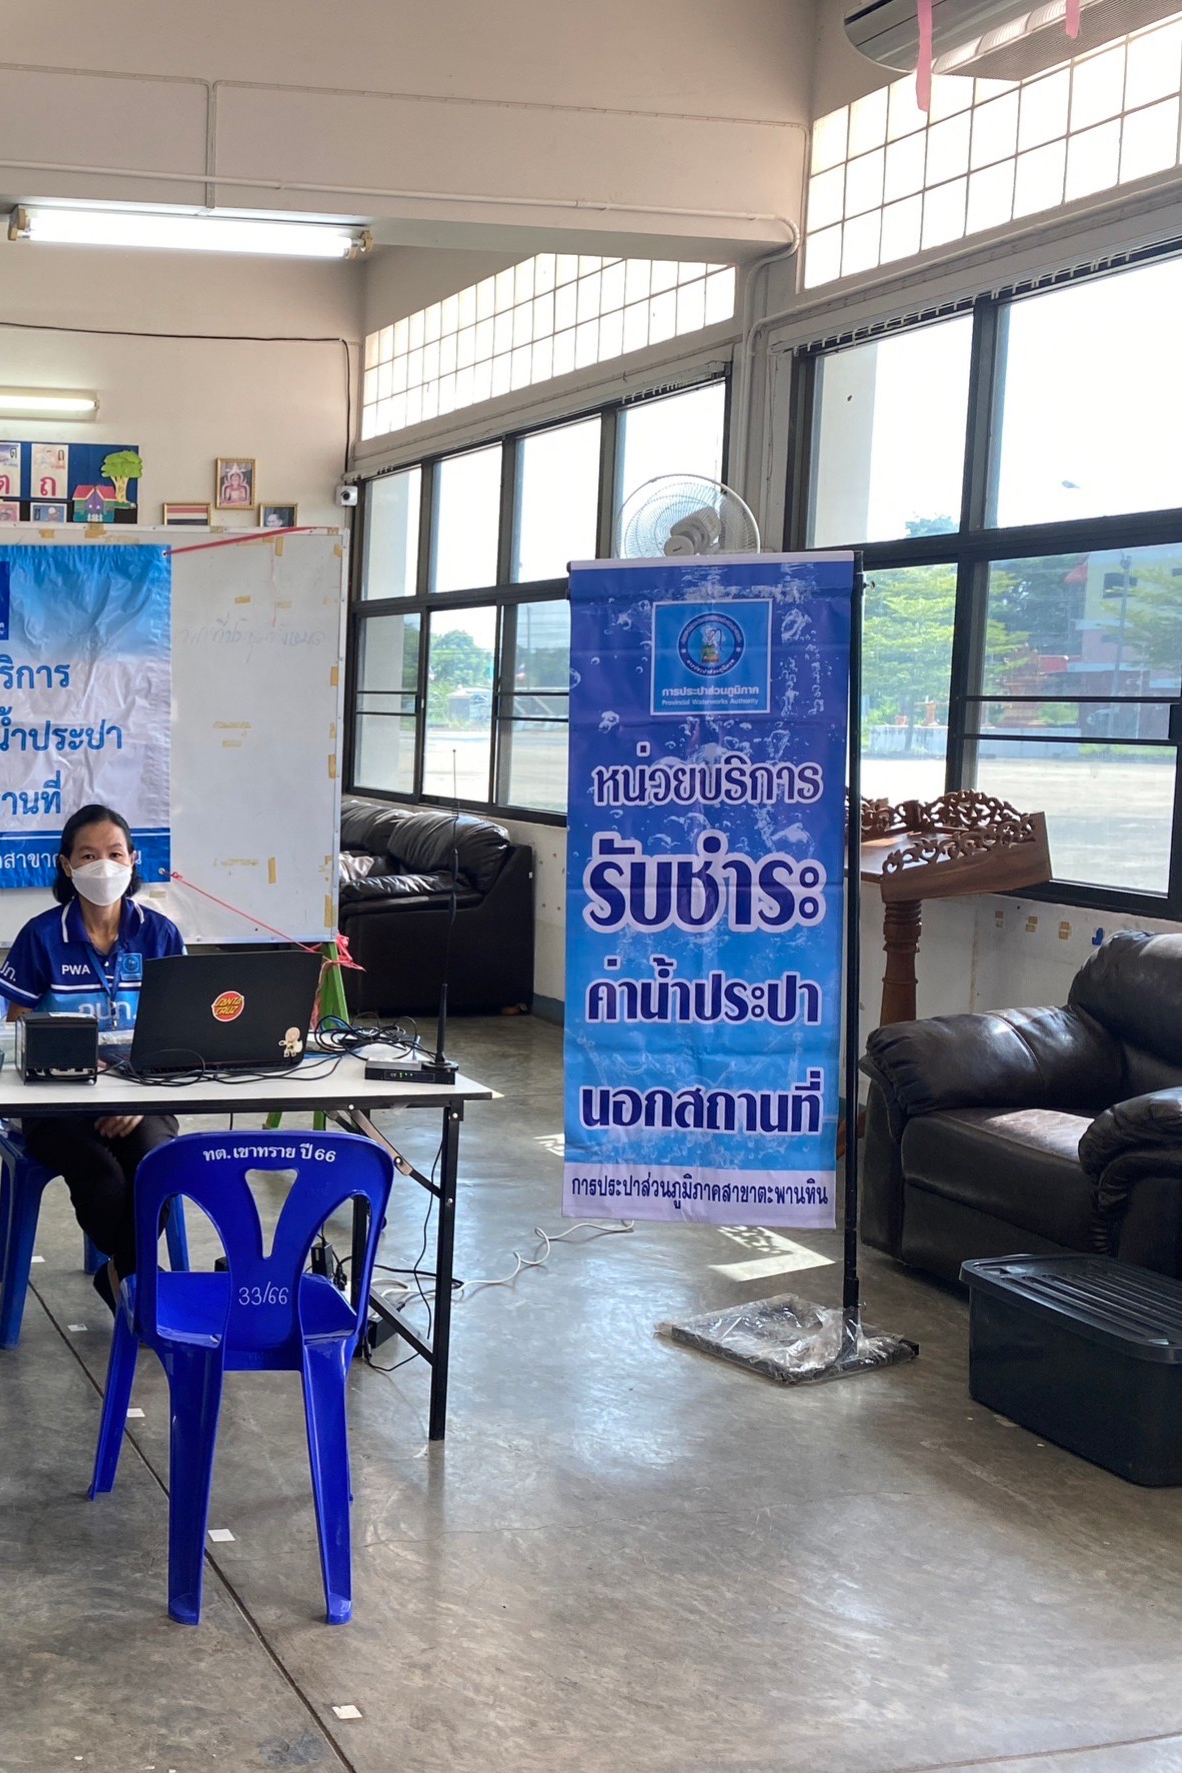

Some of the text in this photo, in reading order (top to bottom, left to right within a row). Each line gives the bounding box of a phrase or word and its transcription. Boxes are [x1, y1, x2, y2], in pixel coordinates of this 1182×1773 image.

[40, 477, 57, 496] ถ
[662, 685, 759, 698] การประปาส่วนภูมิภาค
[592, 742, 824, 805] หน่วยบริการ
[583, 829, 827, 932] รับชำระ
[61, 964, 91, 976] PWA
[585, 954, 821, 1026] ค่าน้ำประปา
[579, 1067, 825, 1136] นอกสถานที่
[571, 1171, 828, 1209] การประปาส่วนภูมิภาคสาขาตะพานหิน
[238, 1281, 289, 1306] 33/66
